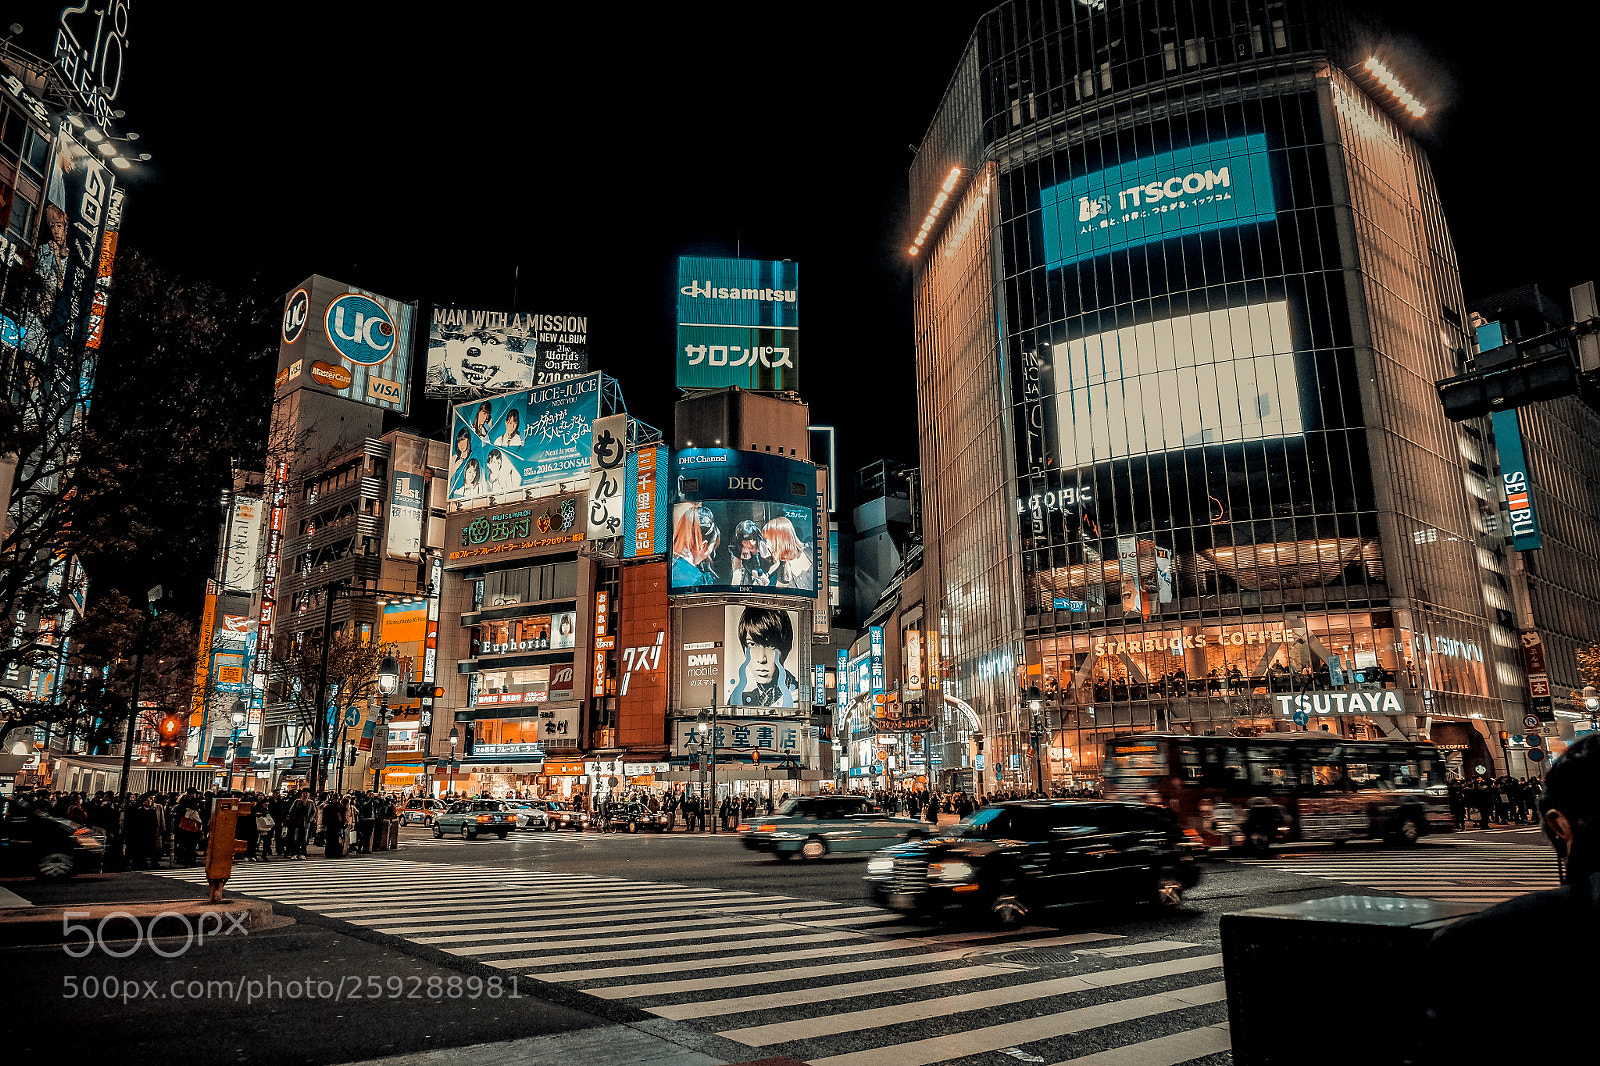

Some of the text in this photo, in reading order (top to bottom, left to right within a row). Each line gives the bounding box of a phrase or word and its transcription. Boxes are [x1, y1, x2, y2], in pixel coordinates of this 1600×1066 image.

[54, 29, 112, 138] RELEASE
[1118, 166, 1230, 210] ITSCOM
[681, 280, 797, 302] Hisamitsu
[433, 308, 588, 334] MAN WITH A MISSION
[540, 332, 587, 345] NEW ALBUM
[545, 350, 580, 361] World's
[556, 344, 573, 353] The
[685, 344, 793, 369] サロンパス
[312, 366, 352, 384] MasterCard
[559, 361, 581, 372] Fire
[537, 371, 561, 385] 2/10
[372, 382, 401, 399] VISA
[545, 449, 558, 457] Next
[678, 454, 727, 465] DHC Channel
[536, 461, 563, 475] 2016.2.3
[563, 459, 576, 470] ON
[591, 429, 623, 534] もんじゃ
[727, 476, 764, 491] DHC
[636, 452, 654, 549] 三千里薬品
[1503, 471, 1535, 538] SEIBU
[491, 518, 531, 541] 西村
[482, 638, 548, 655] Euphoria
[1095, 628, 1294, 657] STARBUCKS COFFEE
[620, 632, 665, 696] クスリ
[688, 653, 718, 667] DMM
[871, 629, 883, 689] 洋服の青山
[551, 667, 573, 686] JTB
[687, 665, 719, 677] mobile
[690, 678, 716, 687] のスマホ
[1277, 692, 1402, 715] TSUTAYA
[684, 726, 797, 749] 大盛堂書店
